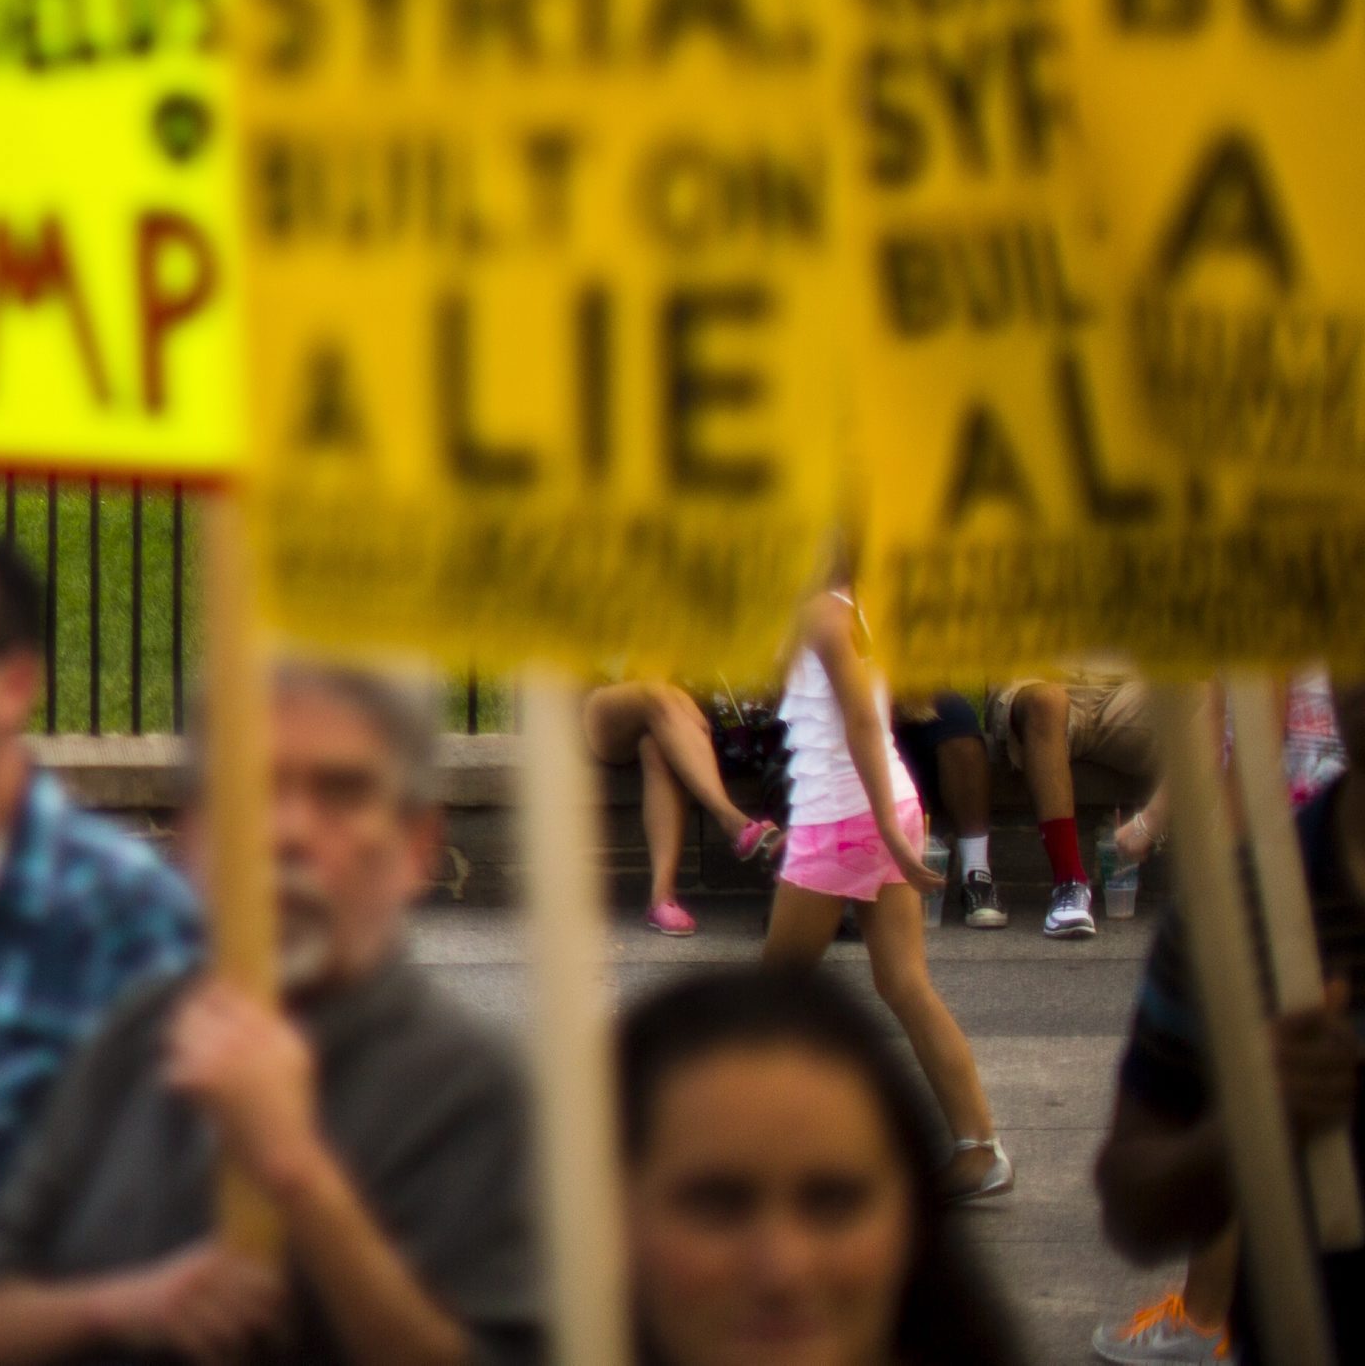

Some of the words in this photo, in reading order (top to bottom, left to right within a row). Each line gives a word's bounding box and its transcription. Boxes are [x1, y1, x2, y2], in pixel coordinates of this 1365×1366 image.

[257, 130, 577, 248] BUILT
[633, 134, 825, 246] ON
[289, 326, 367, 452] A
[431, 280, 785, 500] LIE
